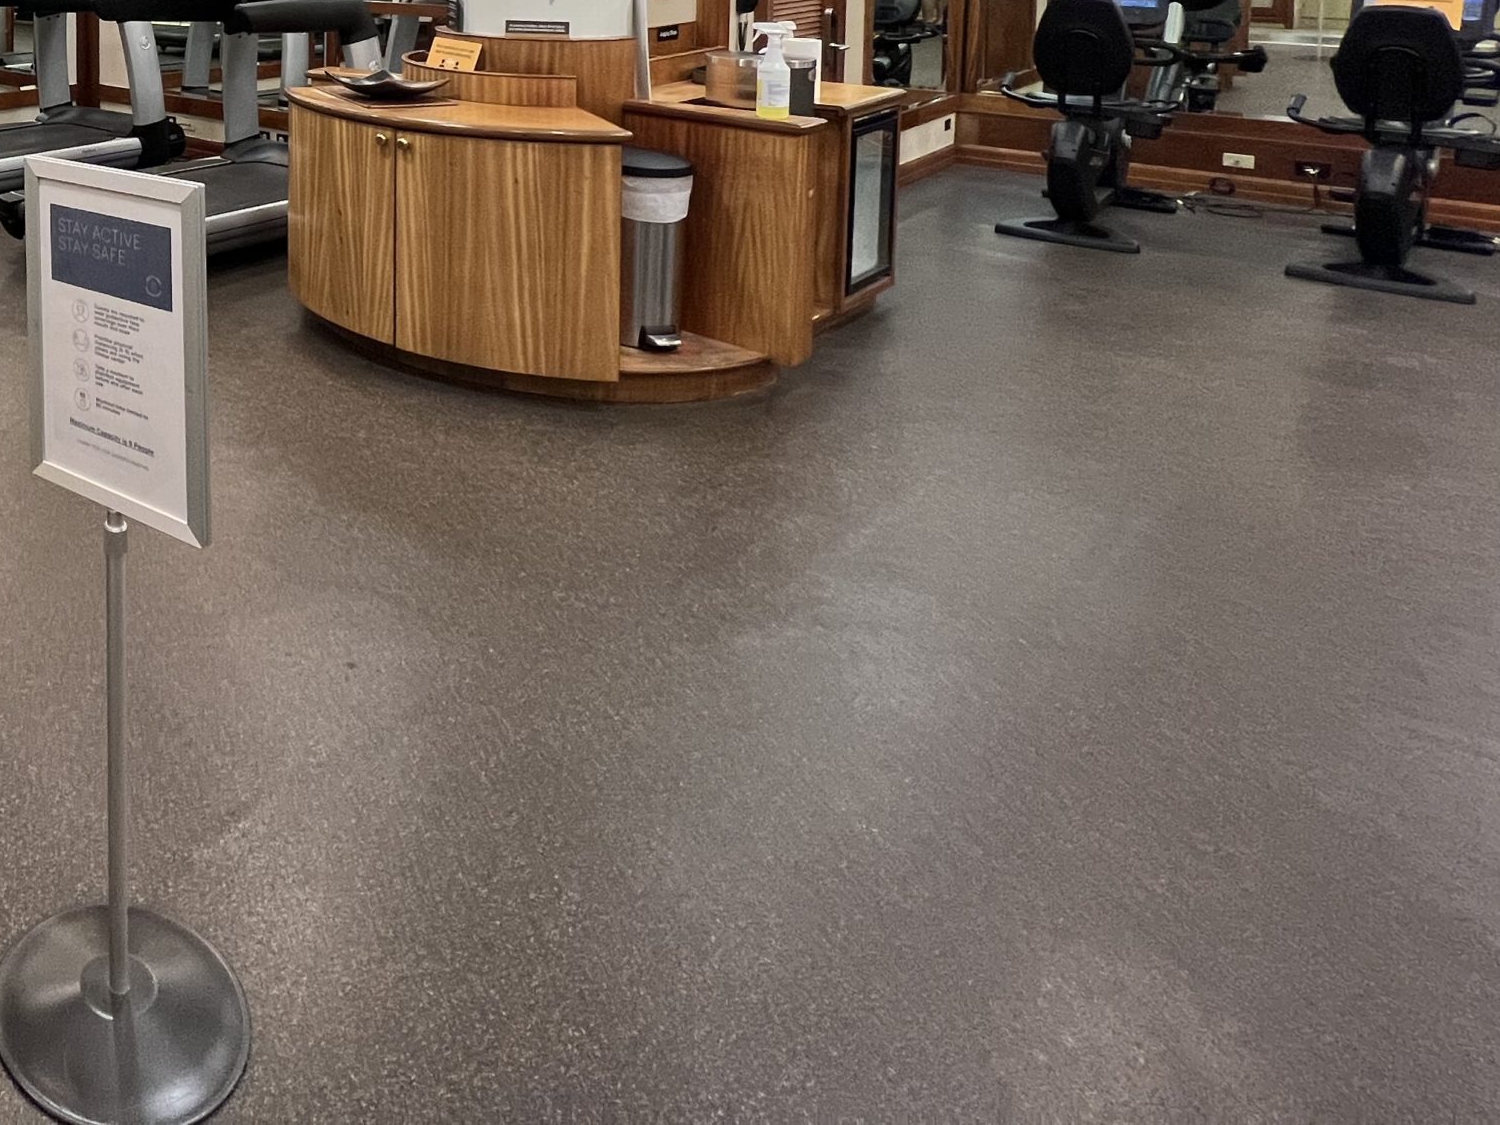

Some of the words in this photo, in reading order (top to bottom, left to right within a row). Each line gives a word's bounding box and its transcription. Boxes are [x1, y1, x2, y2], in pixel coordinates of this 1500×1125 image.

[58, 217, 88, 237] STAY
[92, 225, 141, 251] ACTIVE
[58, 235, 89, 255] STAY
[92, 243, 126, 266] SAFE
